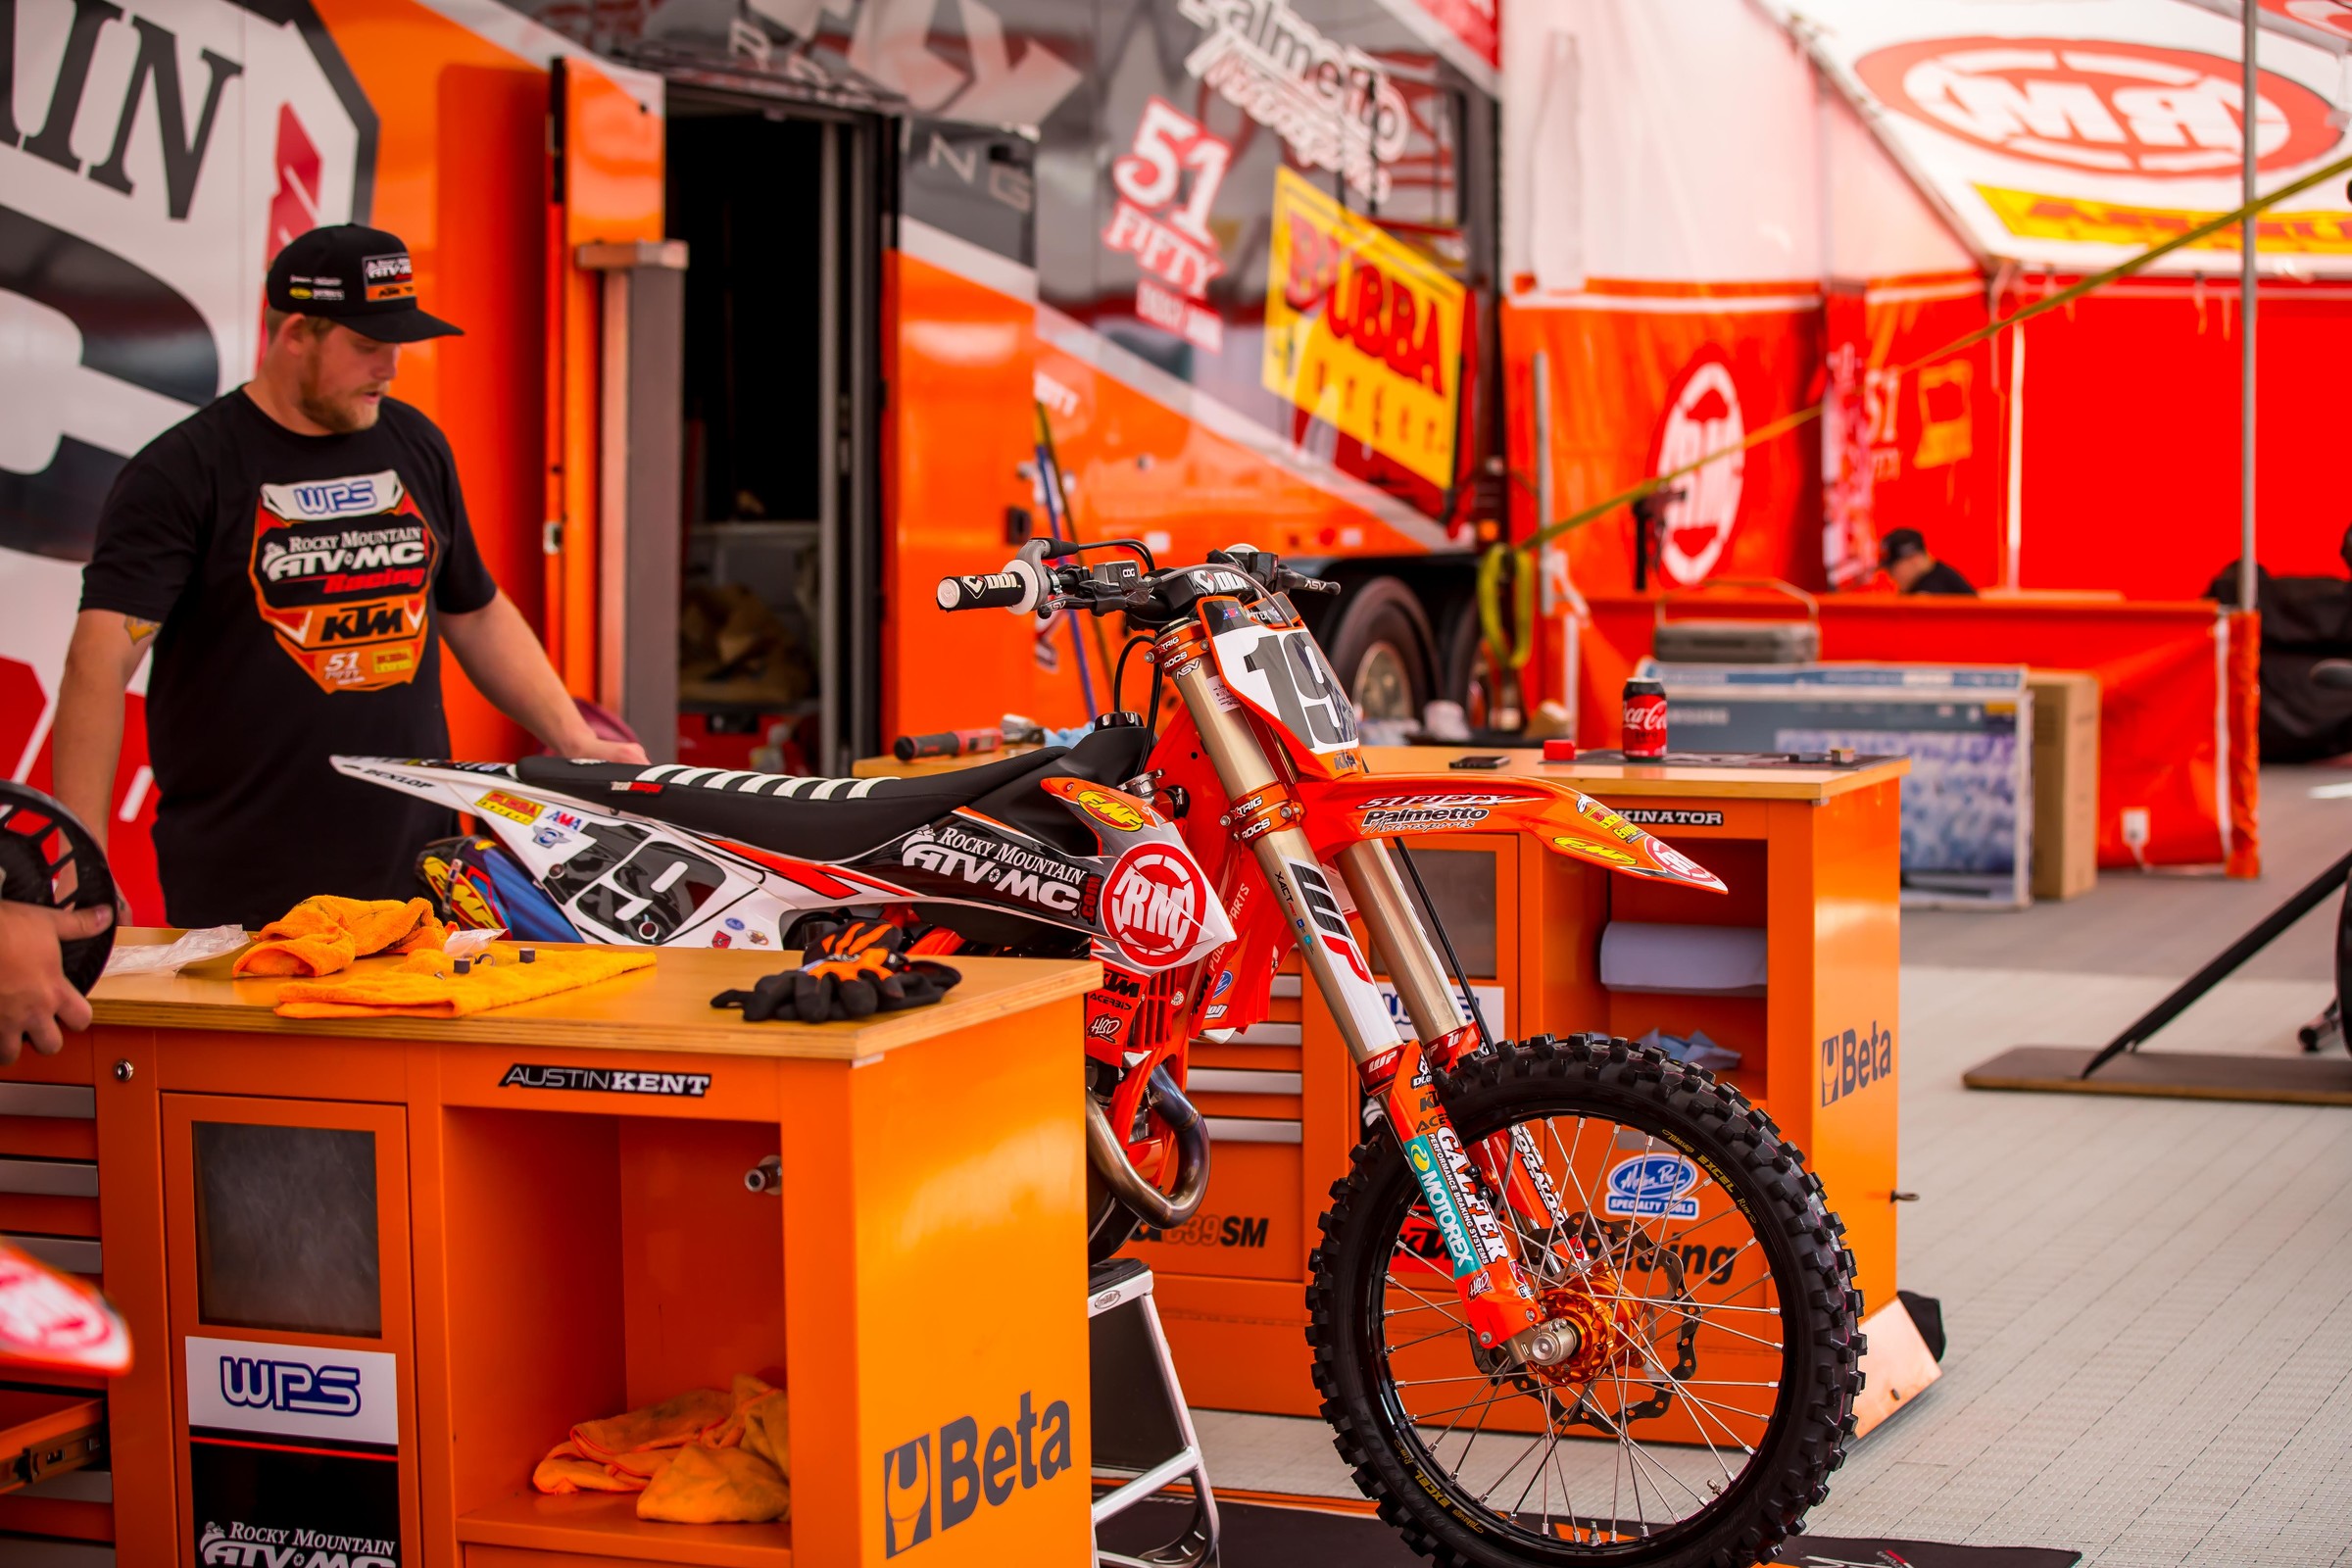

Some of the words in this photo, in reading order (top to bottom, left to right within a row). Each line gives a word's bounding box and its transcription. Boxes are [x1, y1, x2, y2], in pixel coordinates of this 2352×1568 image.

[0, 0, 243, 221] IN
[1112, 98, 1232, 253] 51
[1103, 202, 1223, 294] FIFTY
[294, 479, 378, 515] WPS
[288, 535, 340, 554] ROCKY
[341, 526, 422, 550] MOUNTAIN
[319, 602, 404, 642] KTM
[323, 651, 361, 672] 51
[1157, 635, 1180, 654] XTRIG
[1243, 630, 1358, 750] 19
[547, 809, 583, 831] AMA
[1231, 795, 1263, 820] XTRIG
[1361, 807, 1491, 827] Palmetto
[1361, 817, 1475, 835] Motorsports
[1617, 810, 1723, 824] KINATOR
[1242, 816, 1272, 840] ROCS
[941, 826, 997, 858] ROCKY
[996, 841, 1087, 885] MOUNTAIN
[1274, 870, 1295, 903] XACT
[1842, 1020, 1891, 1098] Beta
[1696, 1153, 1734, 1193] EXCEL
[1428, 1133, 1458, 1191] PERFORMANCE
[1454, 1191, 1474, 1228] BRAKING
[1469, 1227, 1490, 1265] SYSTEMS
[1437, 1126, 1509, 1264] GALFER
[1420, 1169, 1474, 1268] MOTOREX
[220, 1355, 362, 1417] WPS
[939, 1390, 1072, 1532] Beta
[1414, 1469, 1453, 1509] EXCEL
[228, 1521, 290, 1544] ROCKY
[293, 1529, 396, 1556] MOUNTAIN
